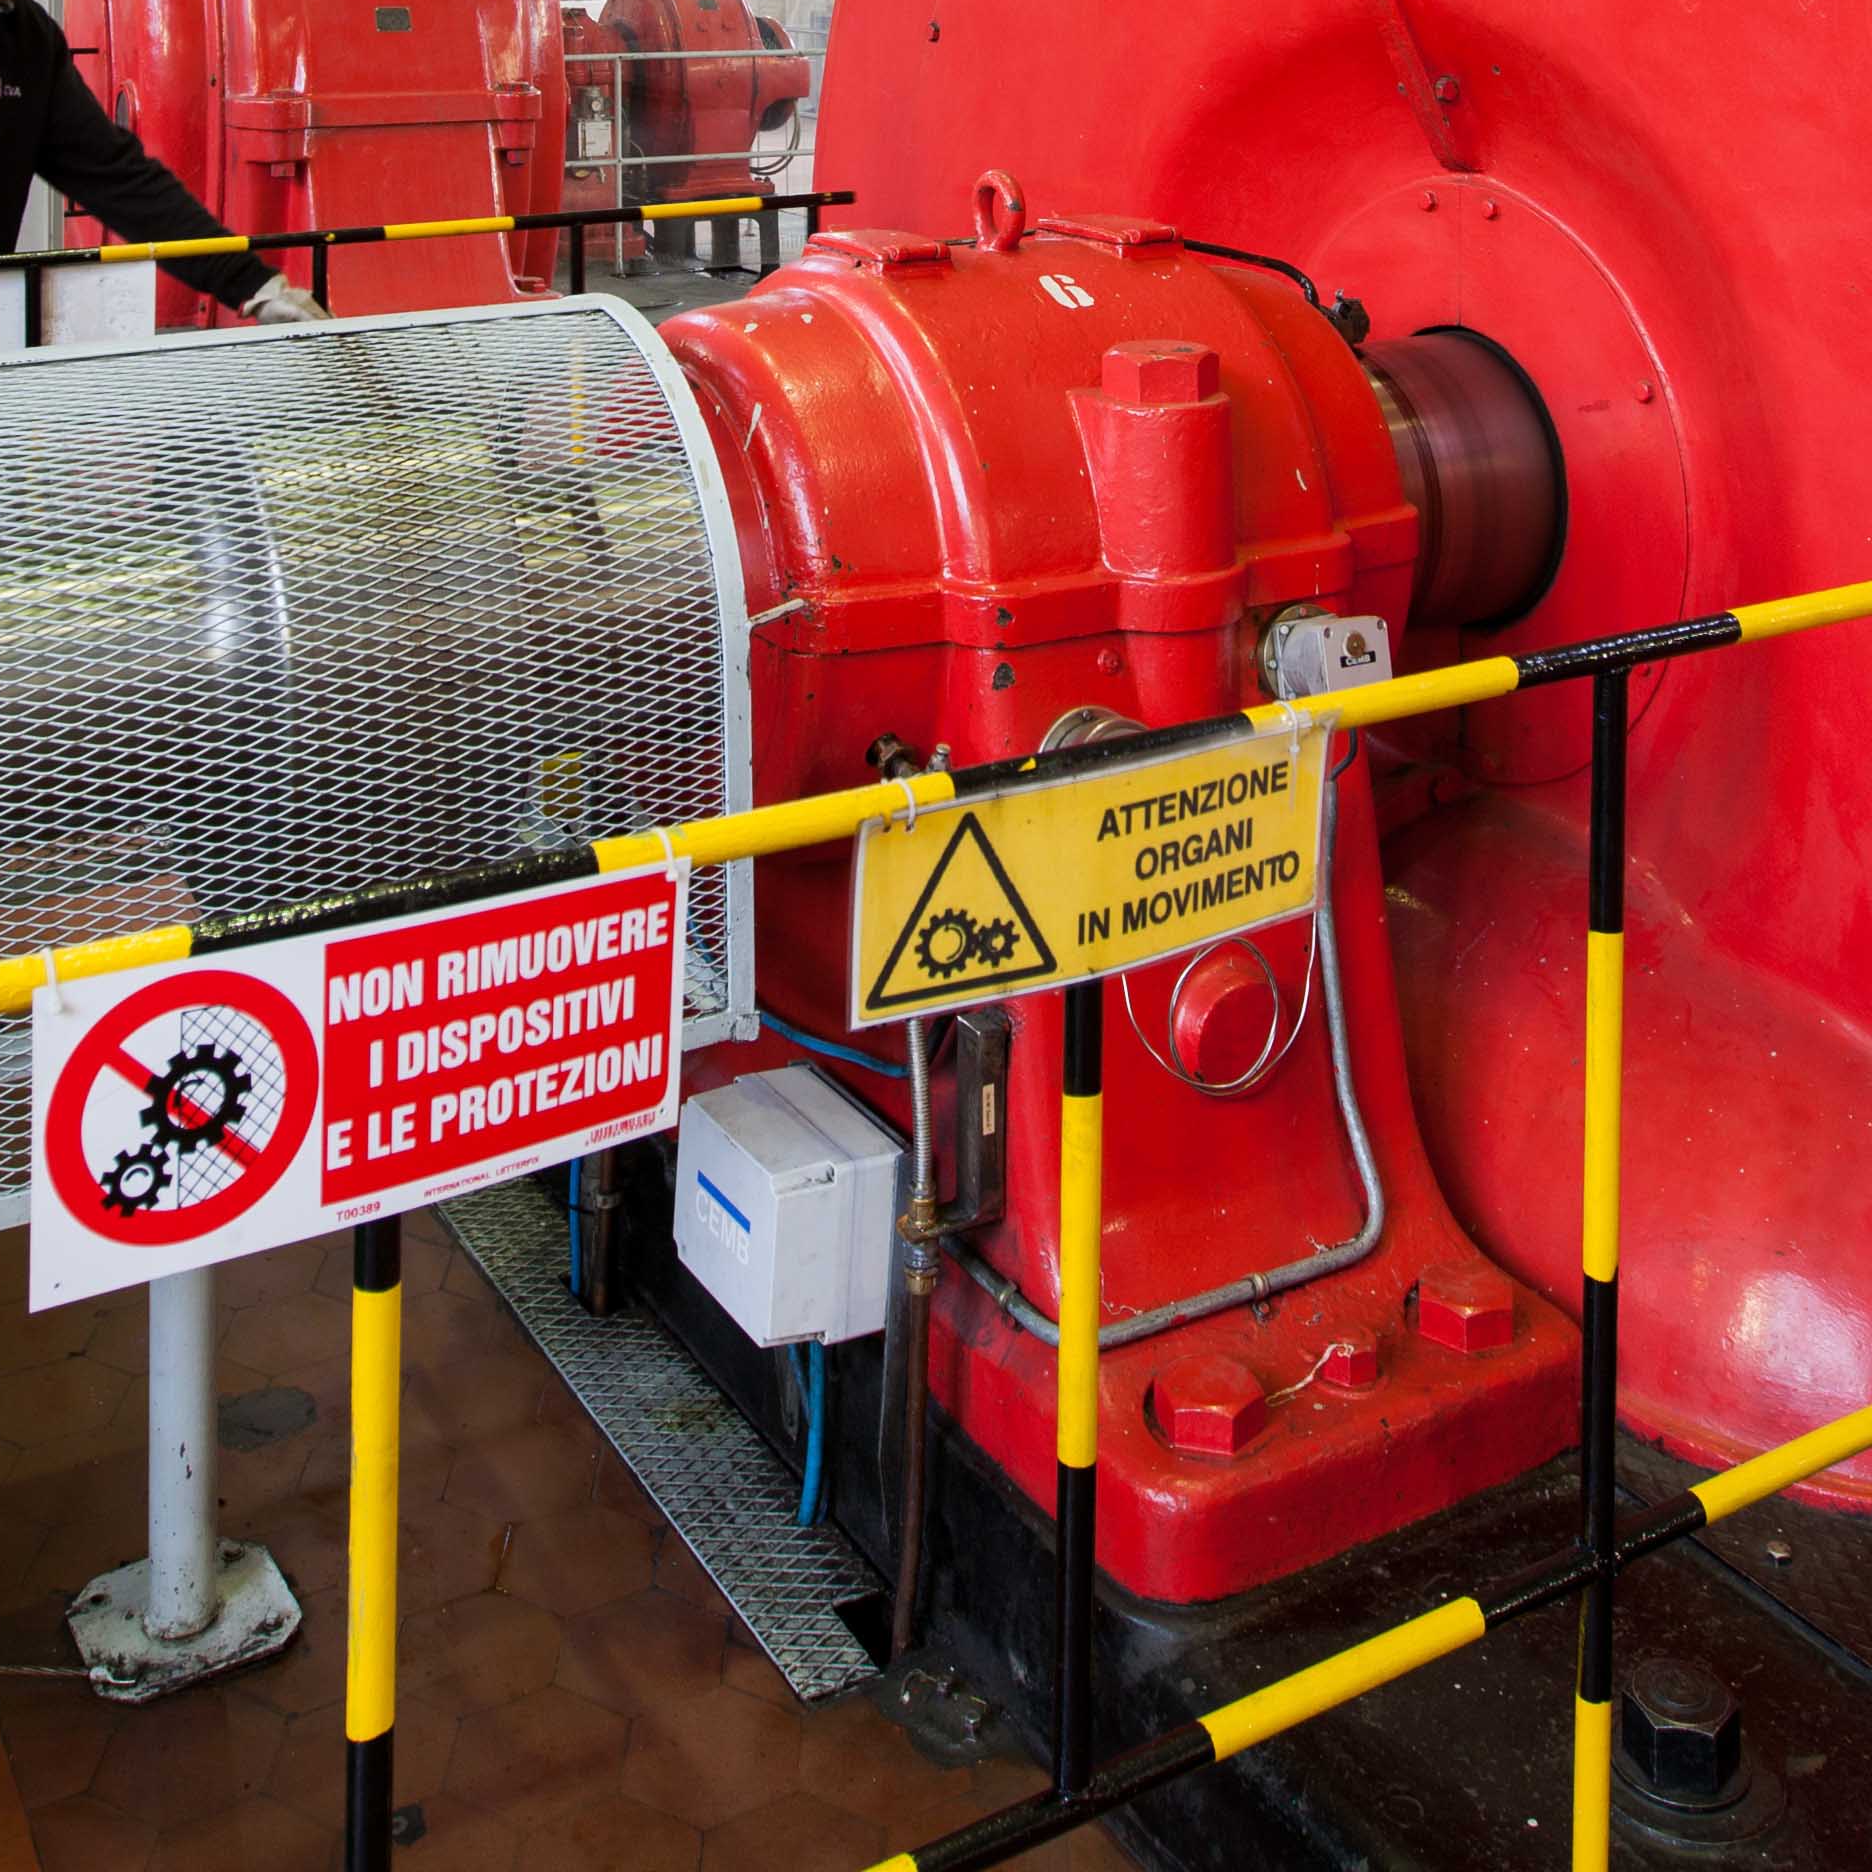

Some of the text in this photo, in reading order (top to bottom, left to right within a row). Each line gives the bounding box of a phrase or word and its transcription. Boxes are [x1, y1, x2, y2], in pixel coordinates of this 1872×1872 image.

[1038, 274, 1095, 310] 6
[1096, 760, 1290, 843] ATTENZIONE
[1134, 816, 1254, 882] ORGANI
[1077, 849, 1301, 946] IN MOVIMENTO
[327, 901, 670, 1026] NON RIMUOVERE
[368, 975, 636, 1089] I DISPOSITIVI
[326, 1118, 354, 1172] E
[366, 1102, 417, 1161] LE
[429, 1033, 664, 1143] PROTEZIONI
[336, 1201, 381, 1222] T00389
[696, 1188, 750, 1265] CEMB
